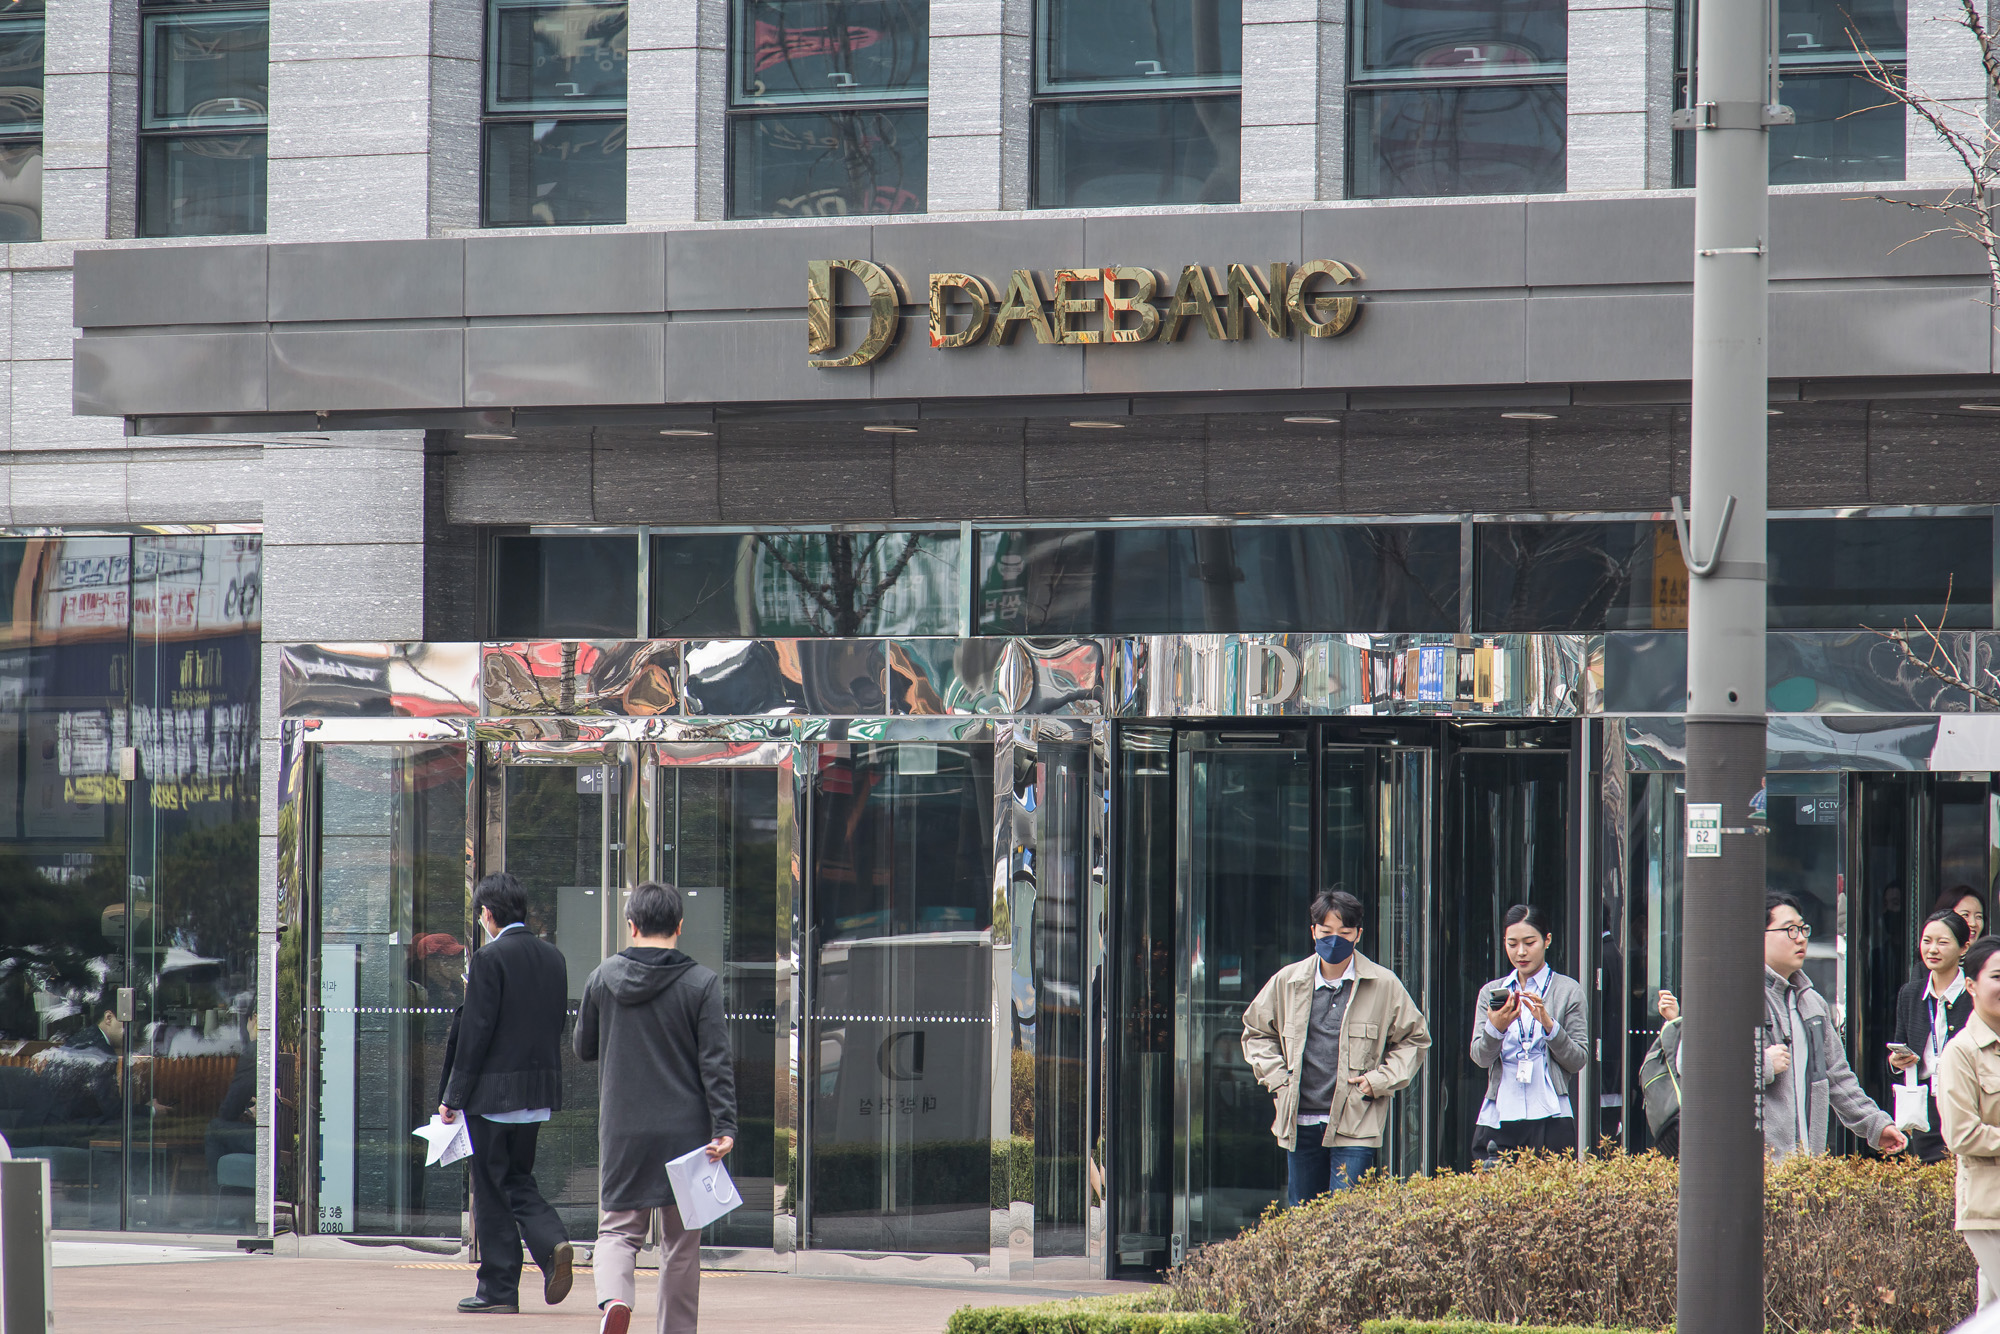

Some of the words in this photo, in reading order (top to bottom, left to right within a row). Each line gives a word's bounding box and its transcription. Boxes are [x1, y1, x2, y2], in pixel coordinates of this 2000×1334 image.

[928, 258, 1363, 348] DAEBANG
[1818, 801, 1839, 809] CCTV
[1696, 830, 1710, 843] 62
[878, 1015, 929, 1023] DAEBANG
[329, 1206, 343, 1219] 3층
[320, 1222, 344, 1233] 2080
